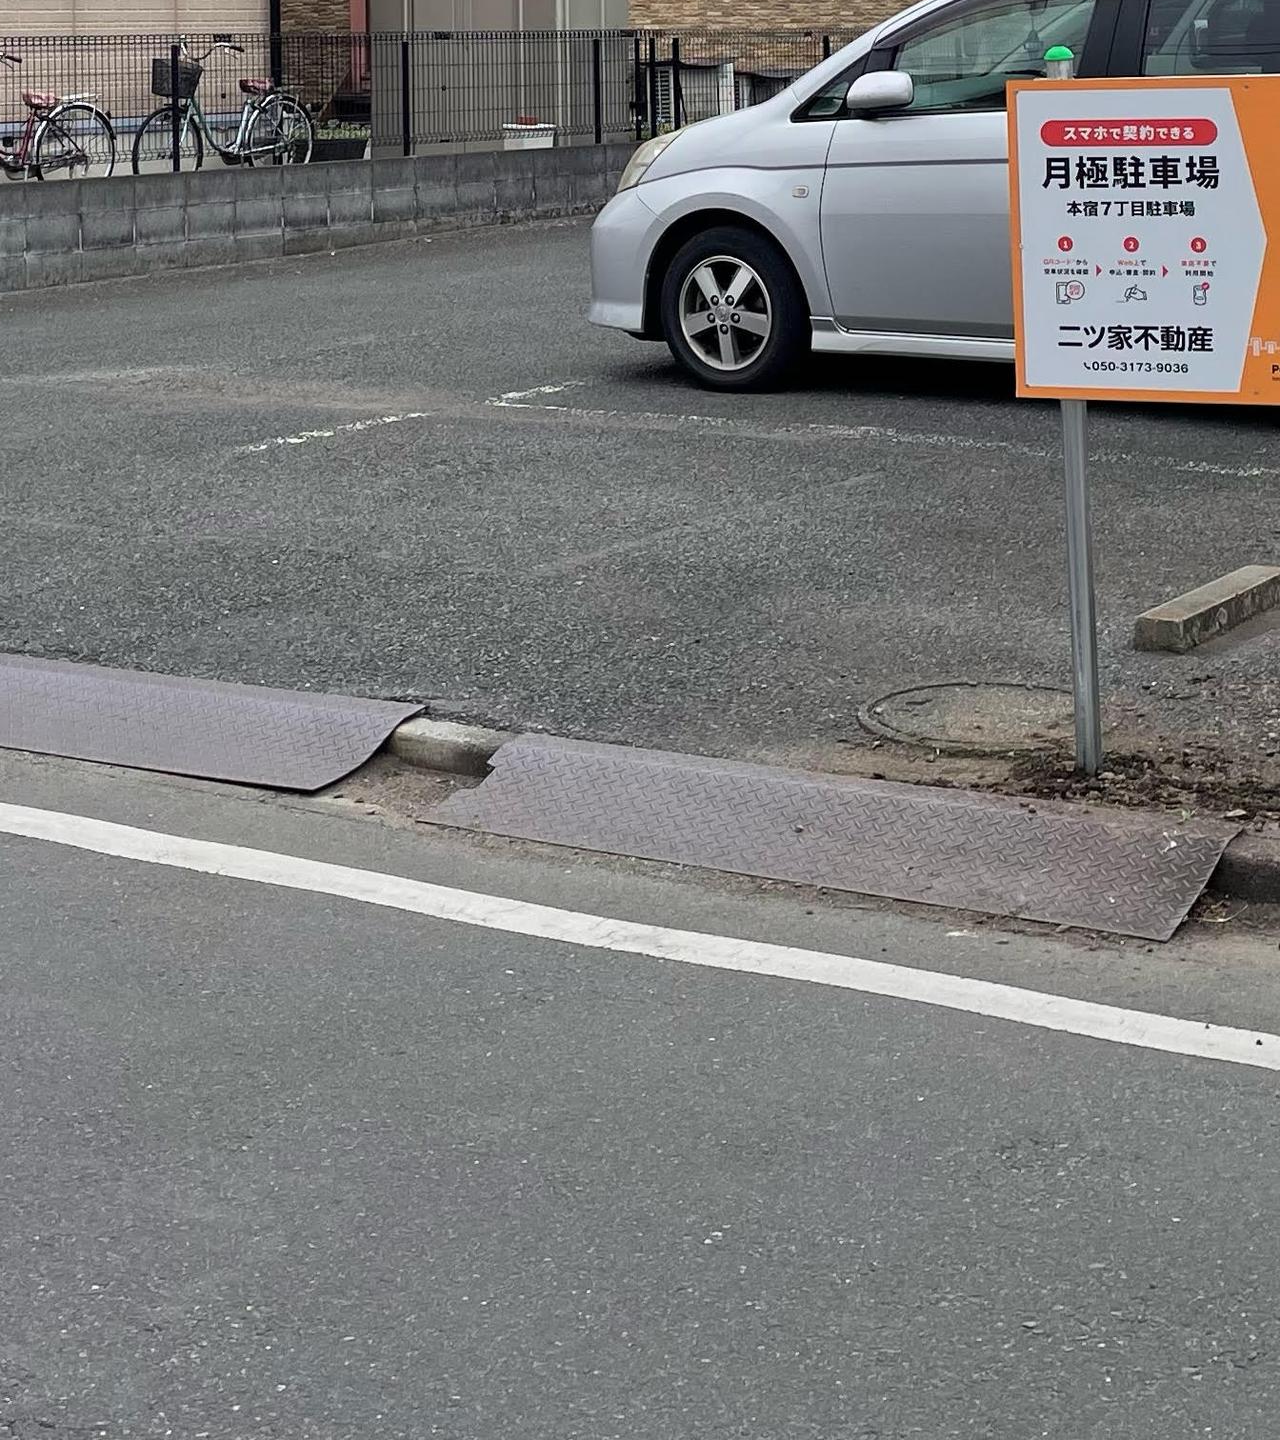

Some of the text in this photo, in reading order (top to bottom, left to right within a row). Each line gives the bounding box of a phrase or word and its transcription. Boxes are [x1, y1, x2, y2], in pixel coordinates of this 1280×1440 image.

[1063, 125, 1195, 140] スマホで契約できる
[1041, 155, 1220, 190] 月極駐車場
[1067, 201, 1196, 217] 本宿7丁目駐車場
[1058, 325, 1213, 352] 二ツ家不動産
[1091, 361, 1189, 373] 050-3173-9036
